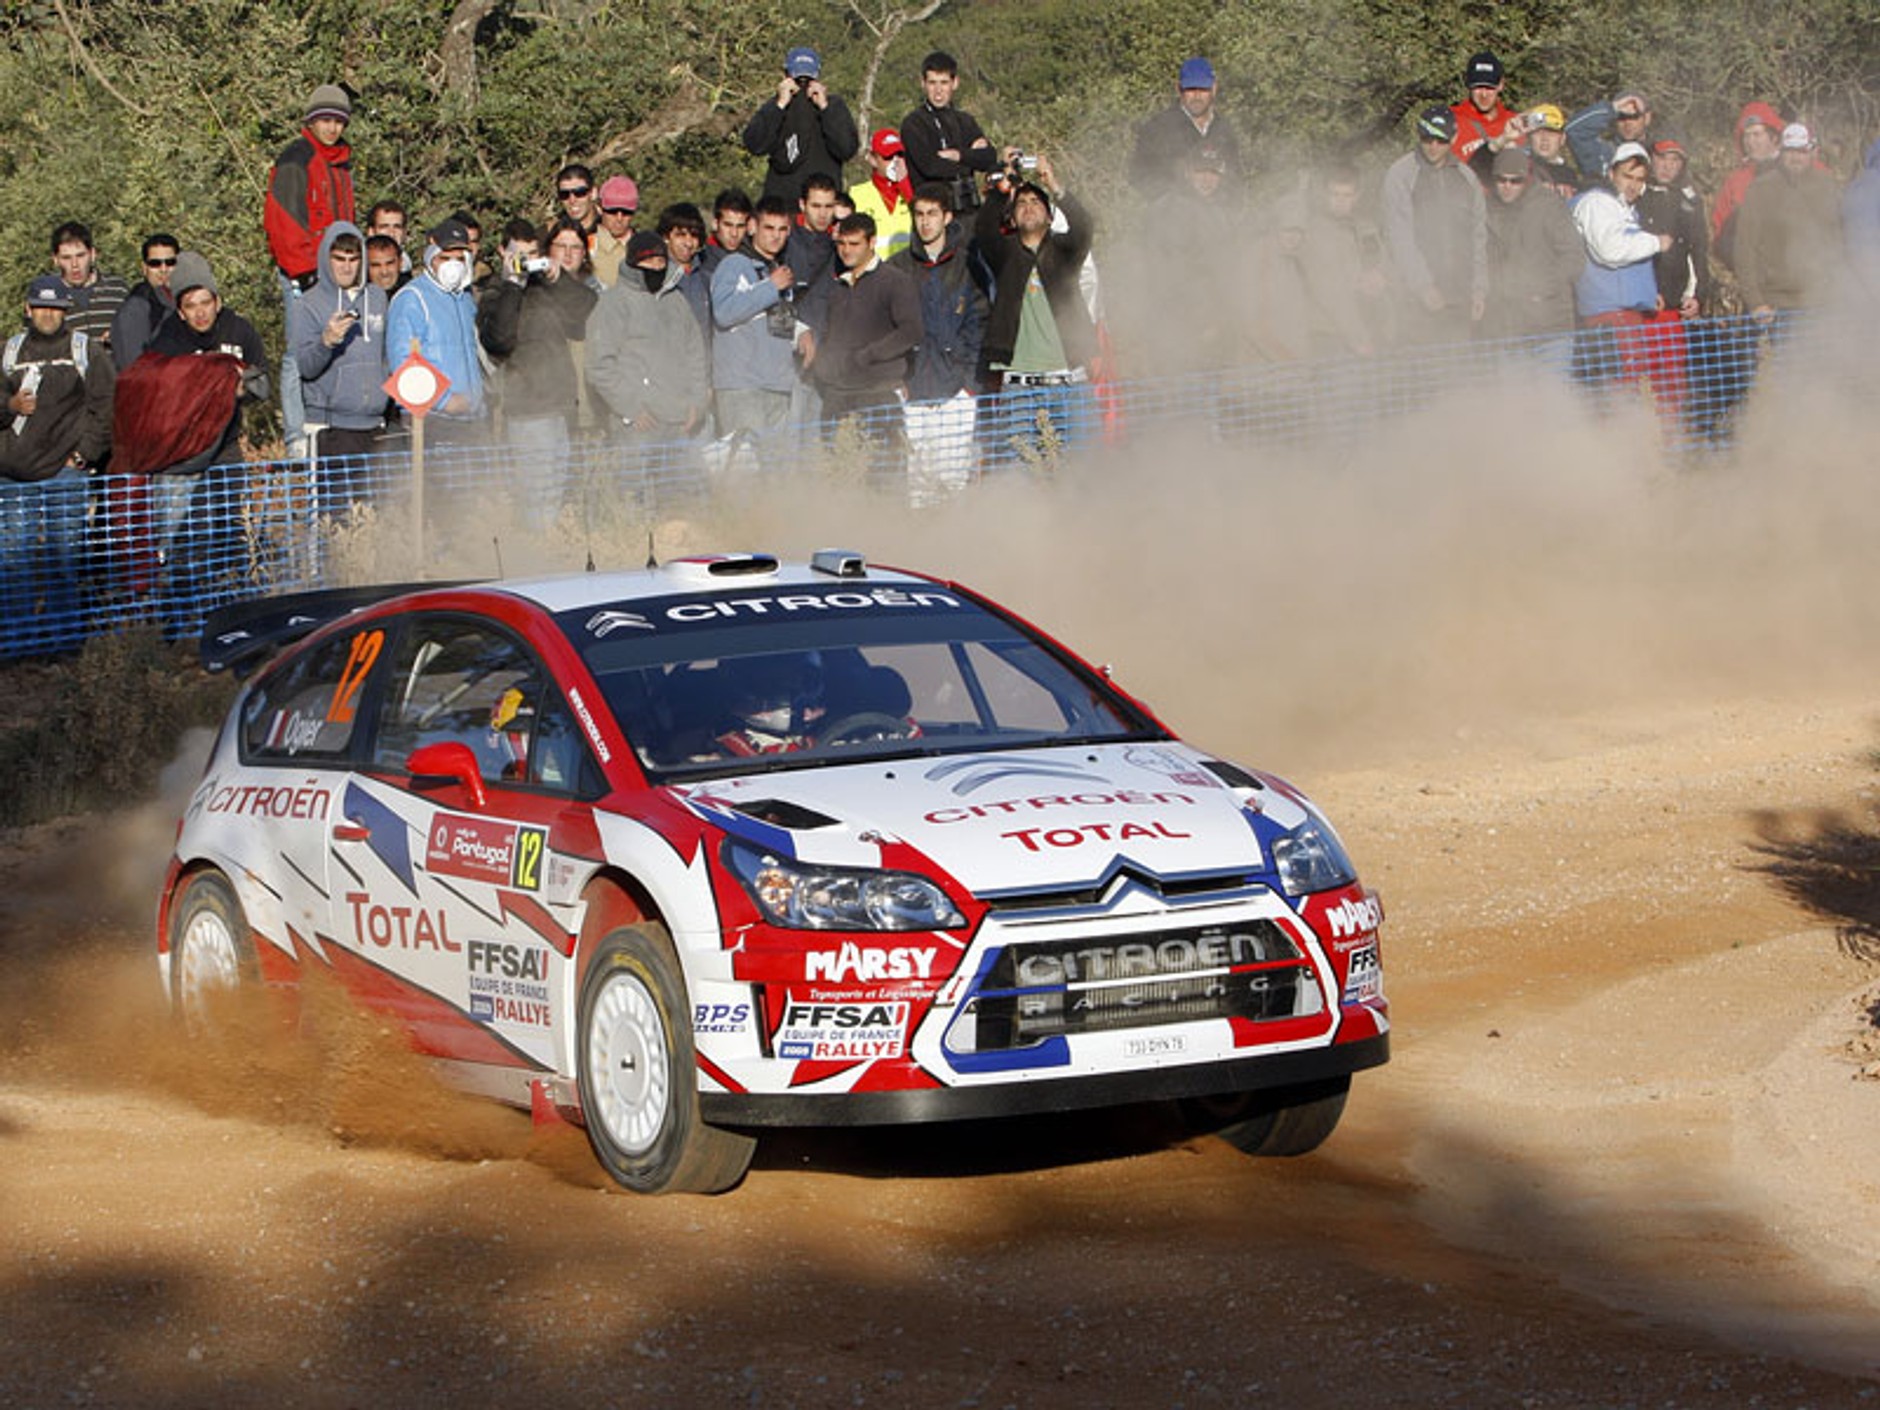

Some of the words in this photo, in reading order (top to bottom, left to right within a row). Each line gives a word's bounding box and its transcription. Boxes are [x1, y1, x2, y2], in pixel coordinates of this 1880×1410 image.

[326, 629, 385, 723] 12
[452, 836, 509, 864] Portugal
[518, 831, 542, 888] 12
[468, 940, 540, 980] FFSA
[805, 941, 937, 983] MARSY
[496, 998, 551, 1026] RALLYE
[787, 1006, 892, 1028] FFSA
[785, 1029, 825, 1041] EQUIPE
[830, 1029, 845, 1040] DE
[850, 1028, 901, 1040] FRANCE
[815, 1041, 900, 1057] RALLYE
